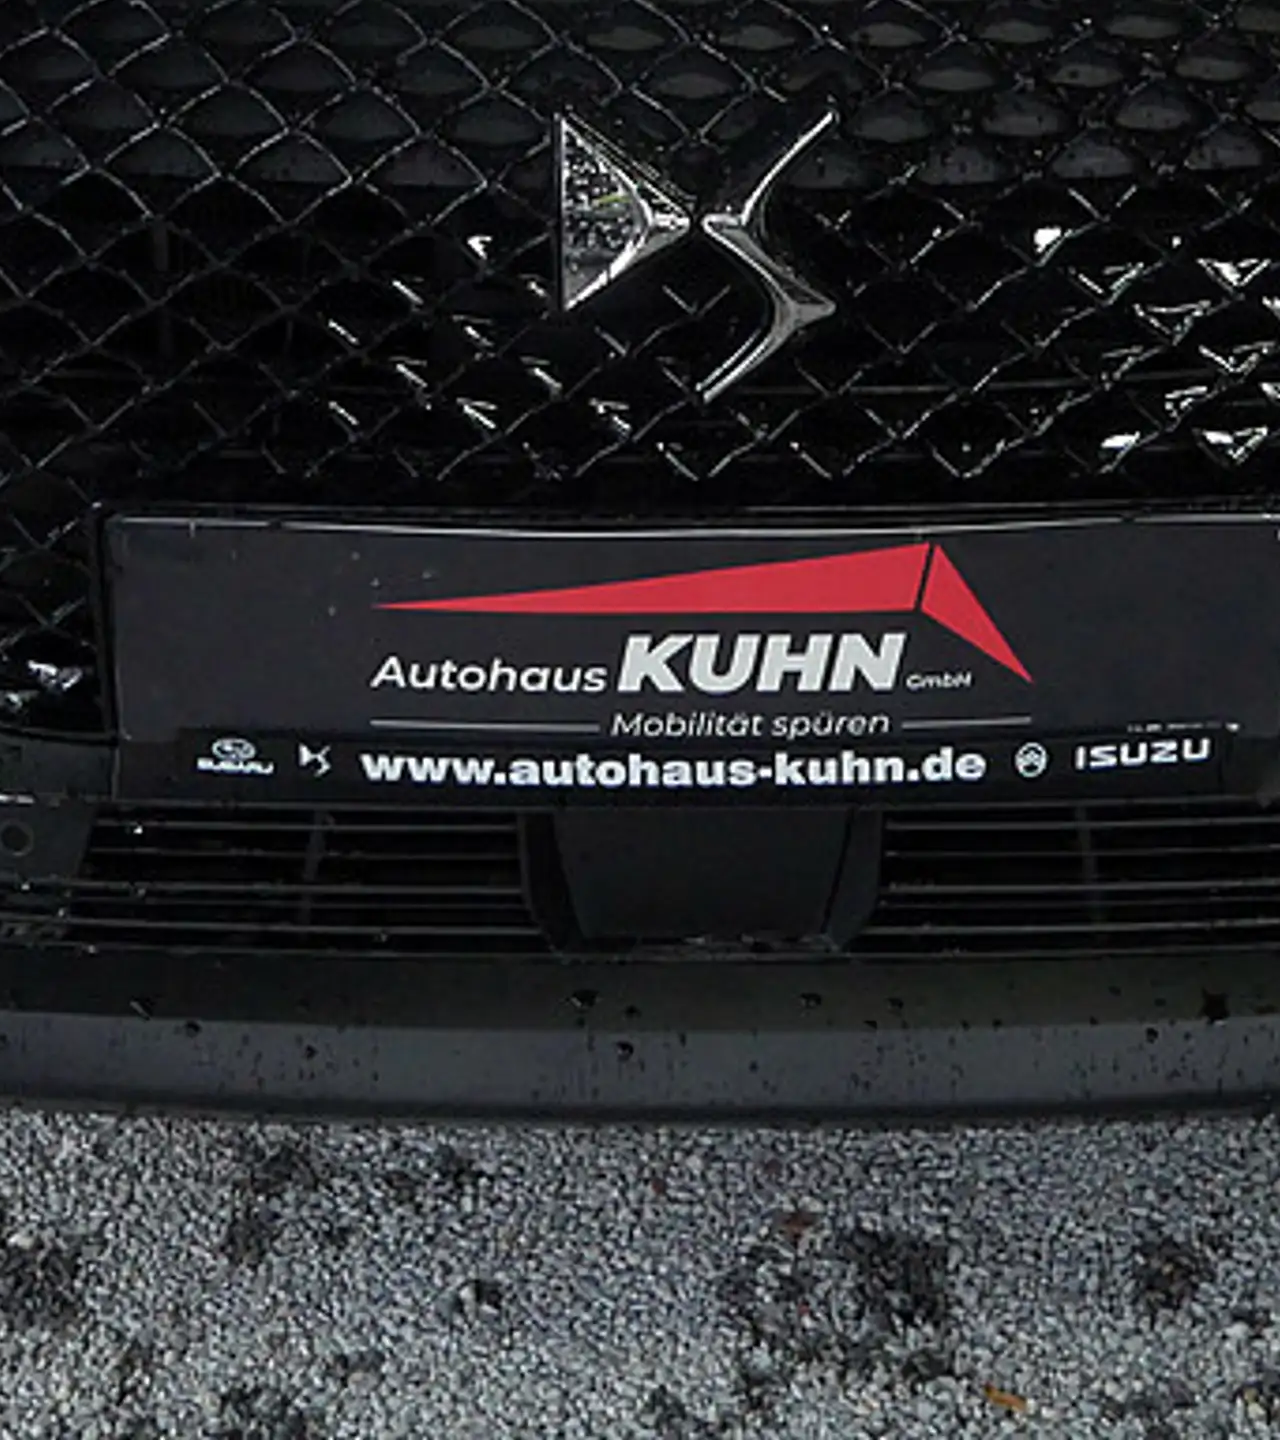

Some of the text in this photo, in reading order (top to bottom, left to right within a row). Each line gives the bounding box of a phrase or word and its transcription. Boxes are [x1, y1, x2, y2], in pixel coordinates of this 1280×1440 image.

[371, 656, 608, 692] Autohaus
[618, 633, 906, 693] KUHN
[611, 712, 890, 741] Mobilität spüren
[361, 746, 987, 787] www.autohaus-kuhn.de
[1075, 738, 1210, 770] ISUZU
